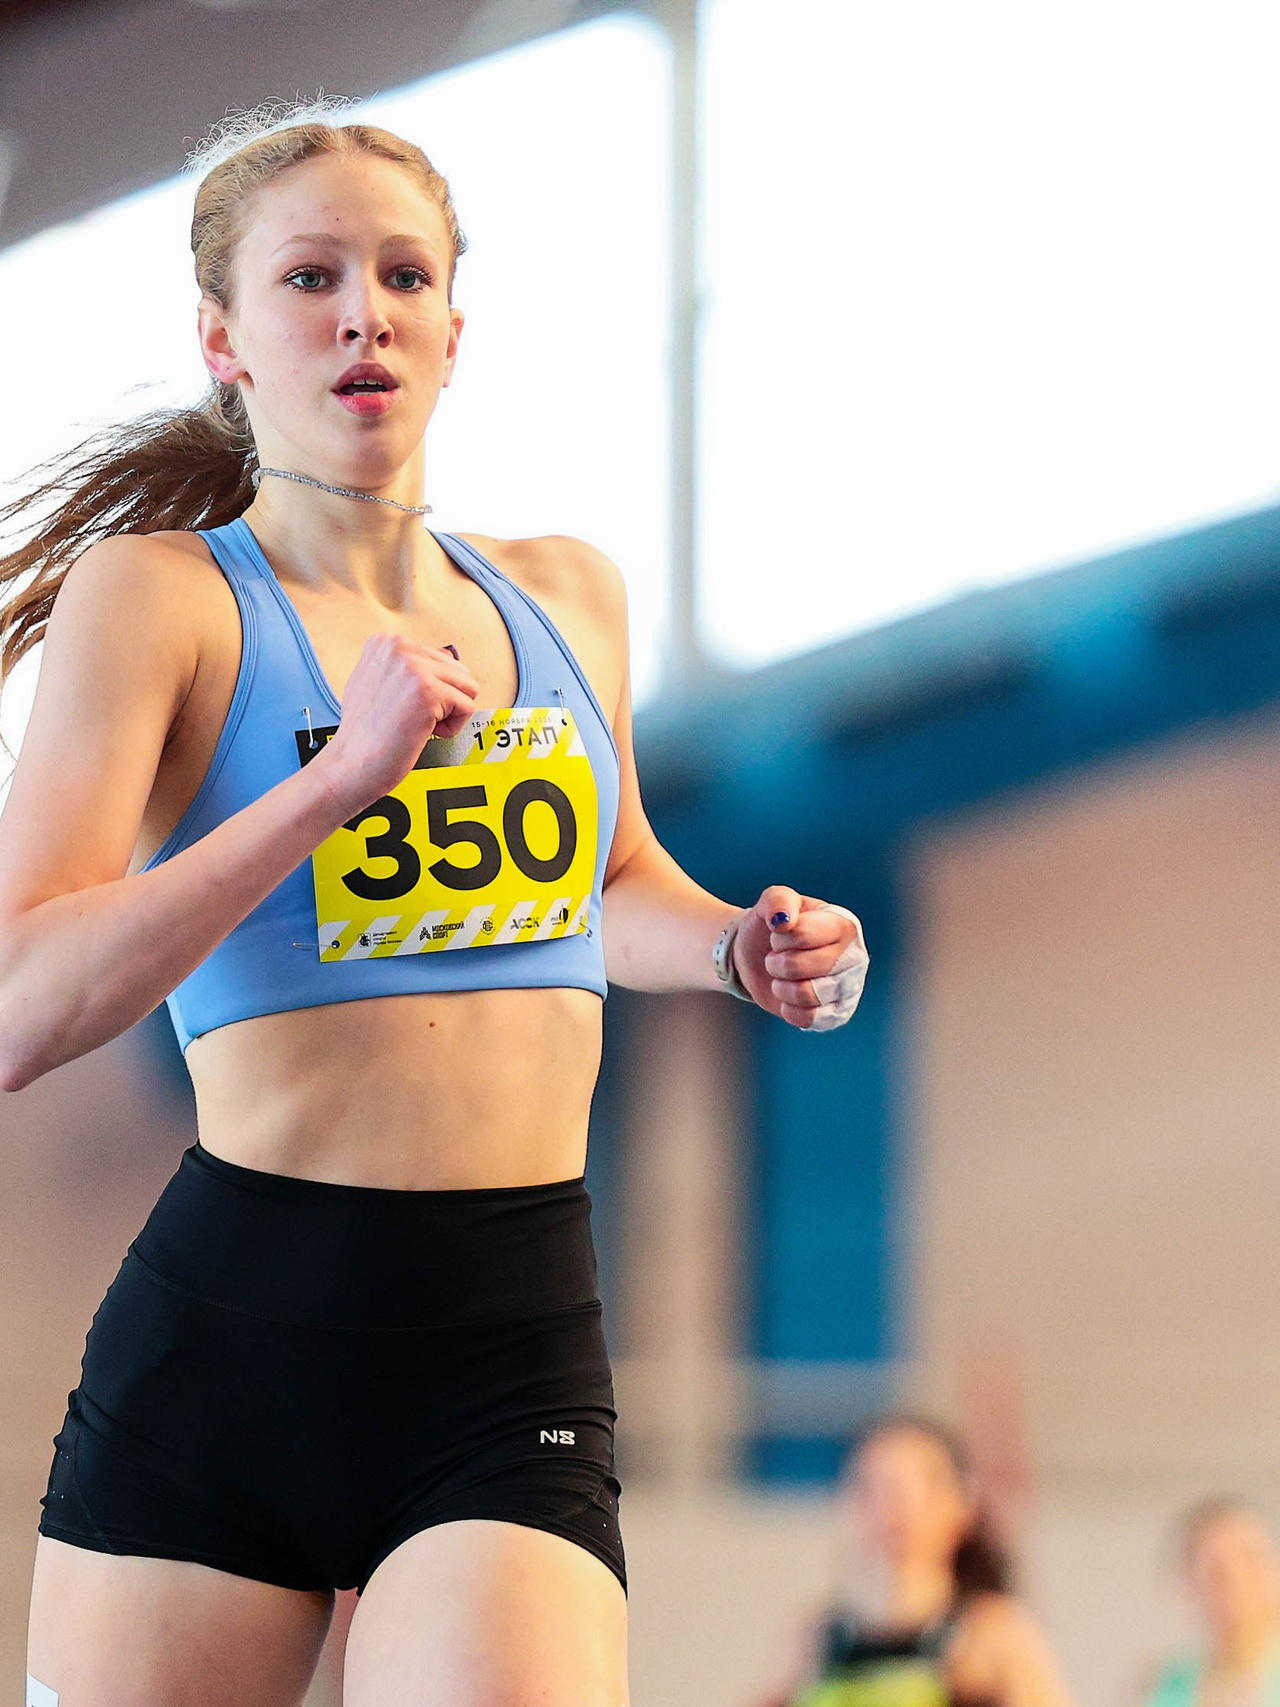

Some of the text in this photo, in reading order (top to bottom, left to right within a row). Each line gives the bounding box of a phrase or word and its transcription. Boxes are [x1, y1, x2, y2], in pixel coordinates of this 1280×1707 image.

[471, 720, 496, 728] 15-16
[473, 726, 558, 750] 1 ЭТАП
[341, 779, 577, 901] 350
[431, 921, 465, 931] МОСКОВСКИЙ
[432, 931, 449, 940] СПОРТ
